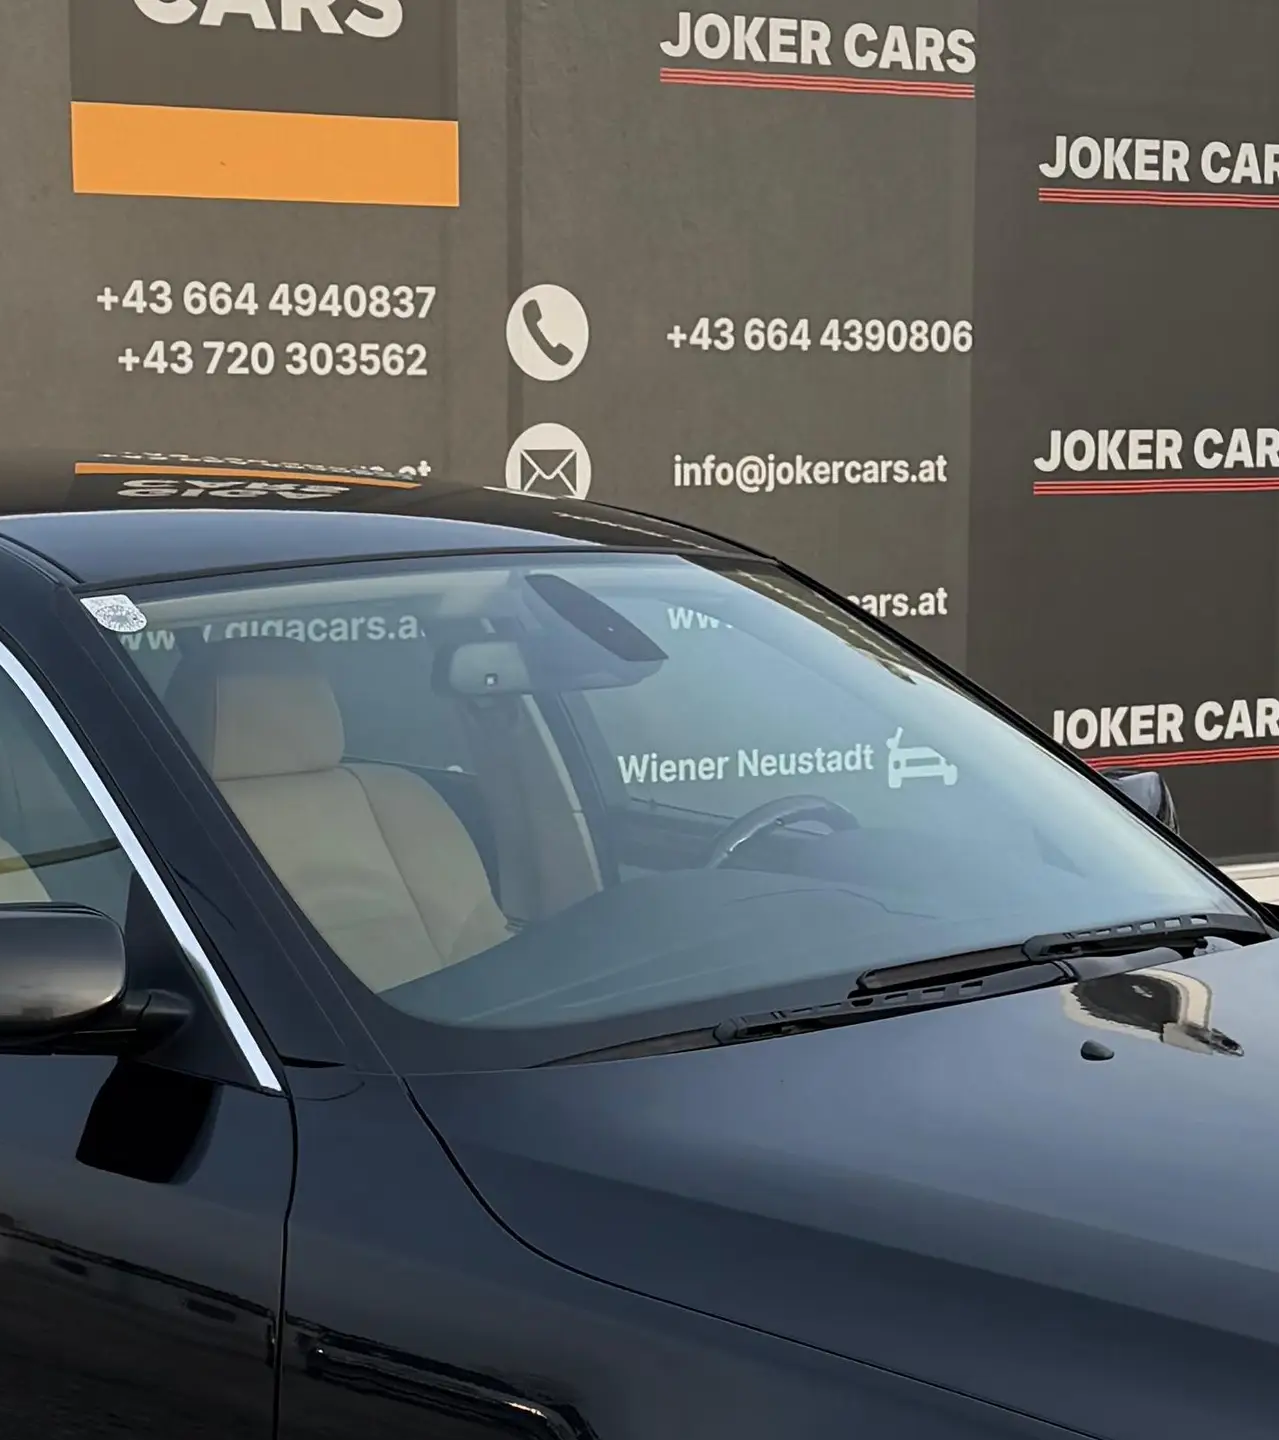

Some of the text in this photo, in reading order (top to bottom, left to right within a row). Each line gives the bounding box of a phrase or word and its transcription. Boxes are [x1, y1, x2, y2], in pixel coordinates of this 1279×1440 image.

[659, 11, 976, 74] JOKER CARS
[1038, 135, 1190, 182] JOKER
[96, 279, 436, 319] +43 664 4940837
[666, 317, 973, 353] +43 664 4390806
[118, 340, 428, 376] +43 720 303562
[1033, 429, 1183, 472] JOKER
[674, 453, 948, 493] info@jokercars.at
[846, 587, 948, 618] ars.at
[1052, 703, 1184, 750] JOKER
[617, 743, 875, 784] Wiener Neustadt
